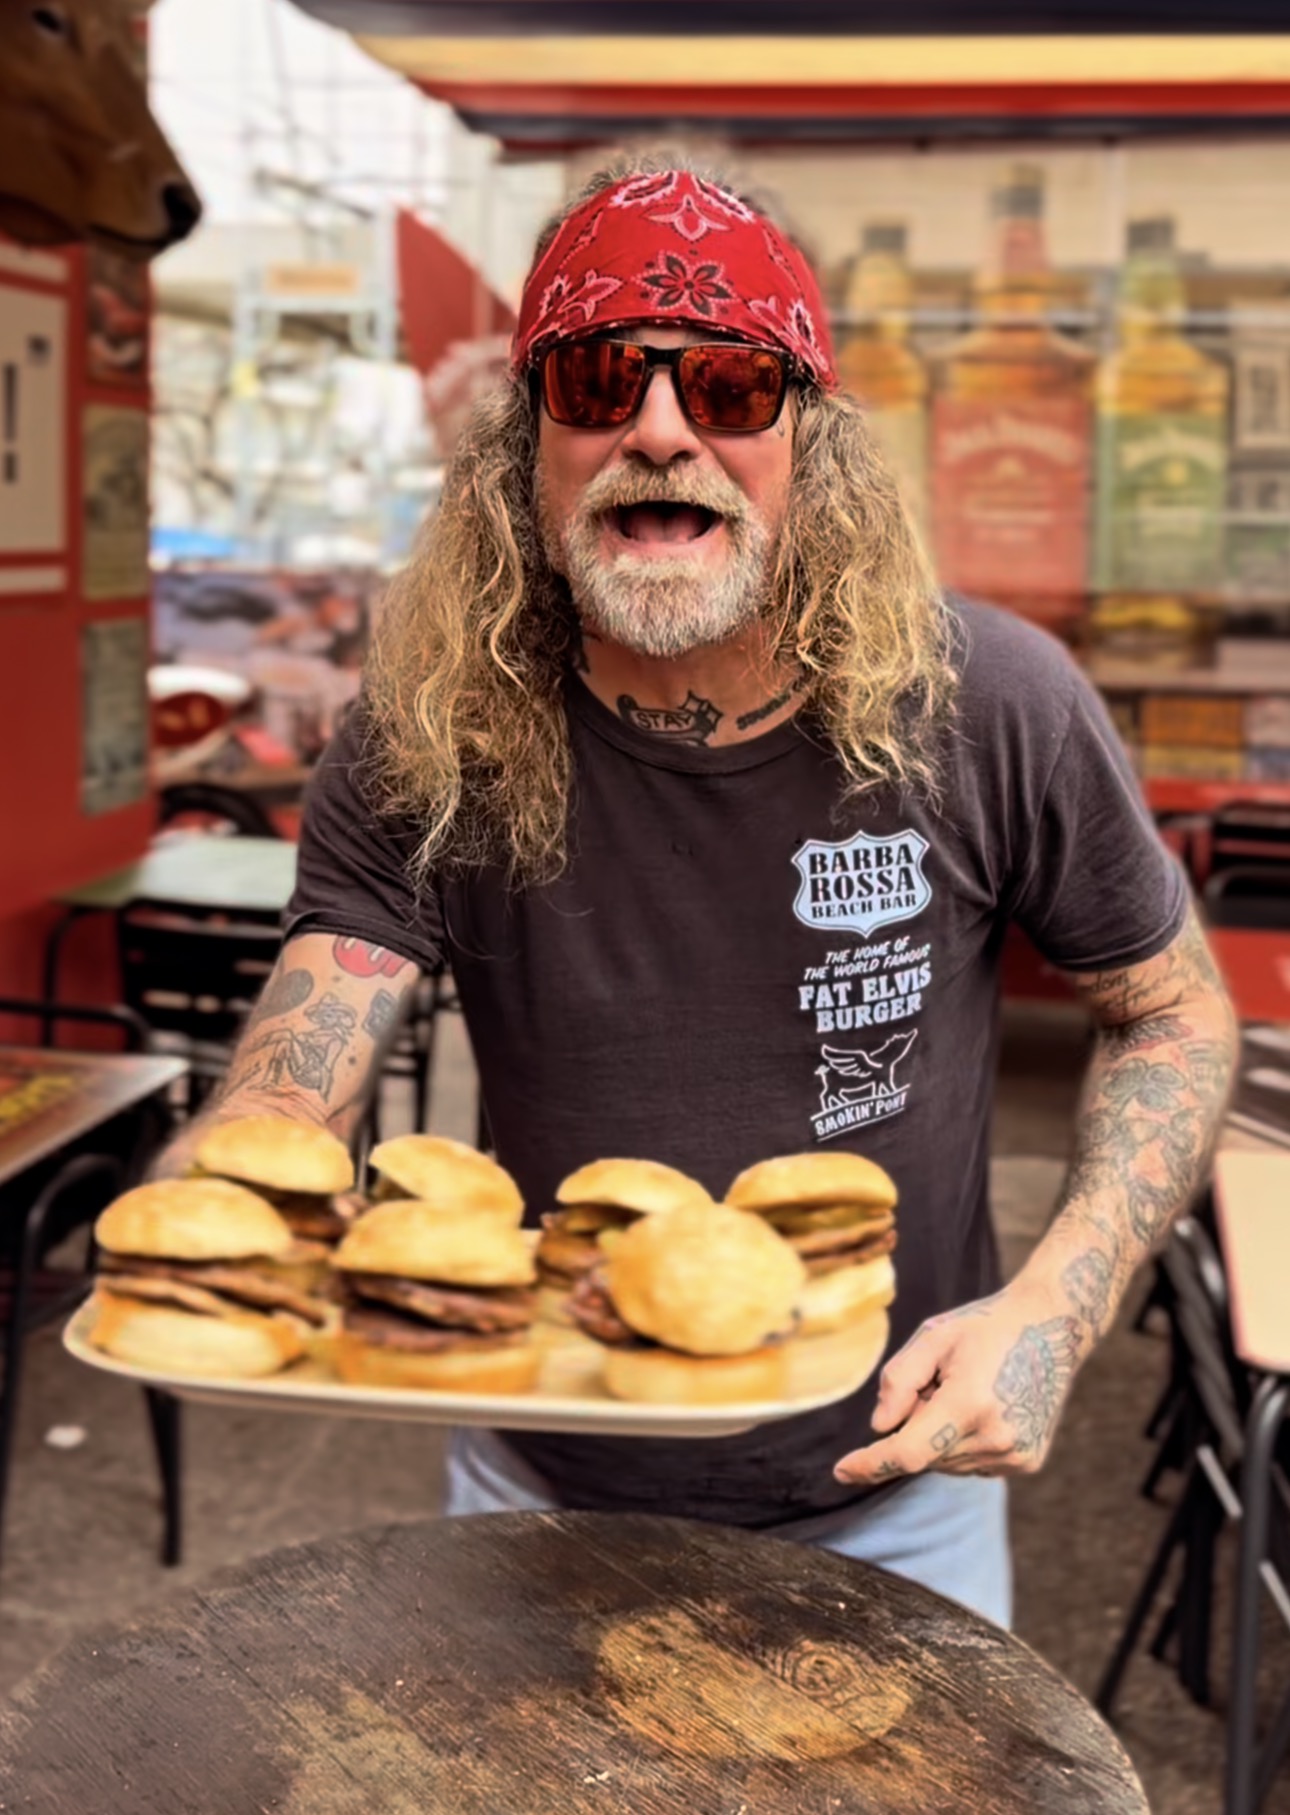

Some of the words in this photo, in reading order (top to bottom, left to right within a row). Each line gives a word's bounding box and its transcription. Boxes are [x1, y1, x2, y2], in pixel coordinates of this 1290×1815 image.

[636, 711, 692, 729] STAY
[808, 843, 914, 875] BARBA
[810, 866, 916, 903] ROSSA
[811, 901, 873, 919] BEACH
[880, 893, 917, 911] BAR
[803, 966, 829, 982] THE
[834, 958, 880, 978] WORLD
[883, 943, 931, 969] FAMOUS
[825, 949, 850, 965] THE
[853, 941, 891, 961] HOME
[894, 935, 910, 953] OF
[798, 980, 852, 1011] FAT
[862, 961, 932, 1003] ELVIS
[816, 992, 922, 1034] BURGER
